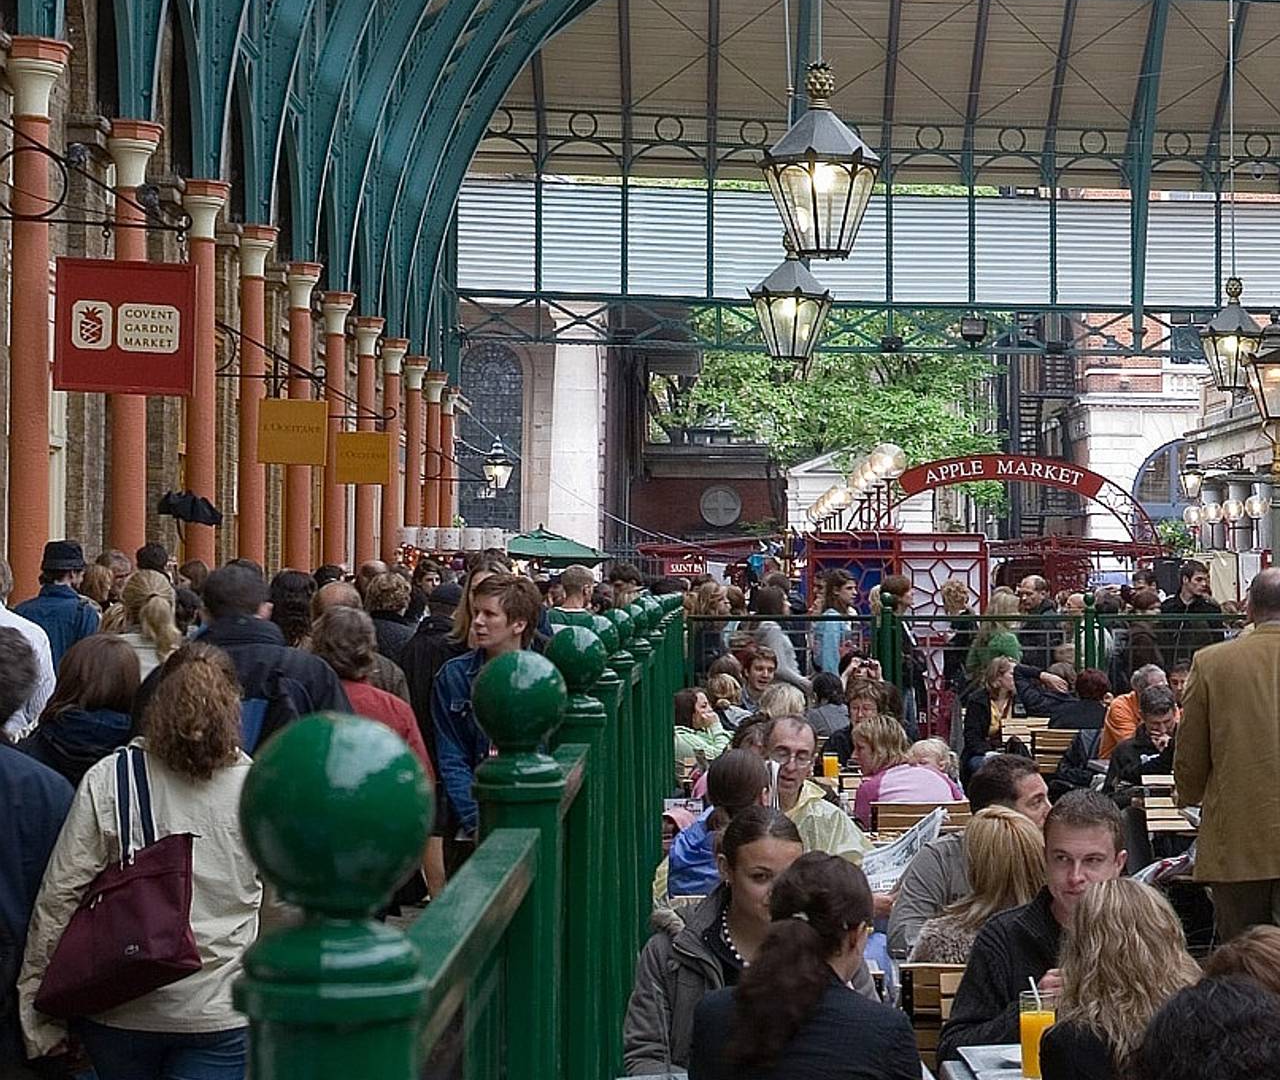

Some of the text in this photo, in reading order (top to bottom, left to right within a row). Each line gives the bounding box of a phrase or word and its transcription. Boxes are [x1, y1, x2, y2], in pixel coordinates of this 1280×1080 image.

[125, 309, 174, 319] COVENT
[124, 323, 174, 334] GARDEN
[123, 337, 173, 348] MARKET
[925, 459, 1084, 486] APPLE MARKET
